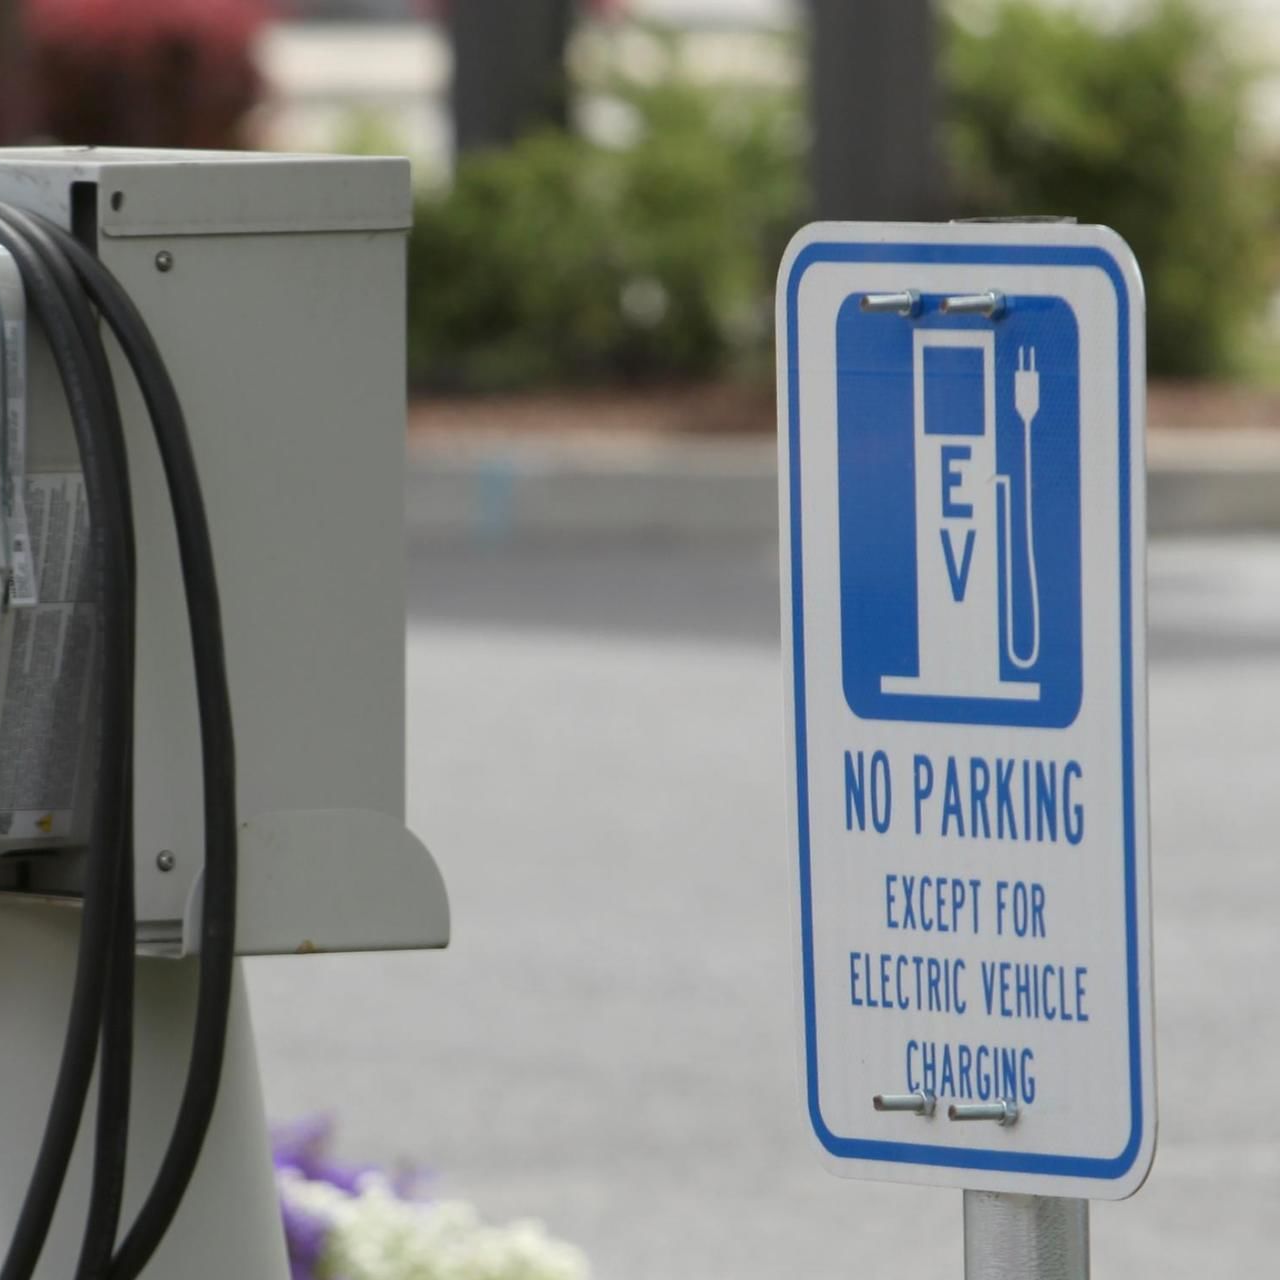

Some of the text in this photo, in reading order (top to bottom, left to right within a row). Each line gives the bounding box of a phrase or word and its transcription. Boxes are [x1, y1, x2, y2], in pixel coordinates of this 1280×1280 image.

[940, 445, 976, 602] EV
[844, 750, 1084, 845] NO PARKING
[885, 875, 1046, 938] EXCEPT FOR
[850, 952, 1089, 1022] ELECTRIC VEHICLE
[906, 1040, 1036, 1104] CHARGING
